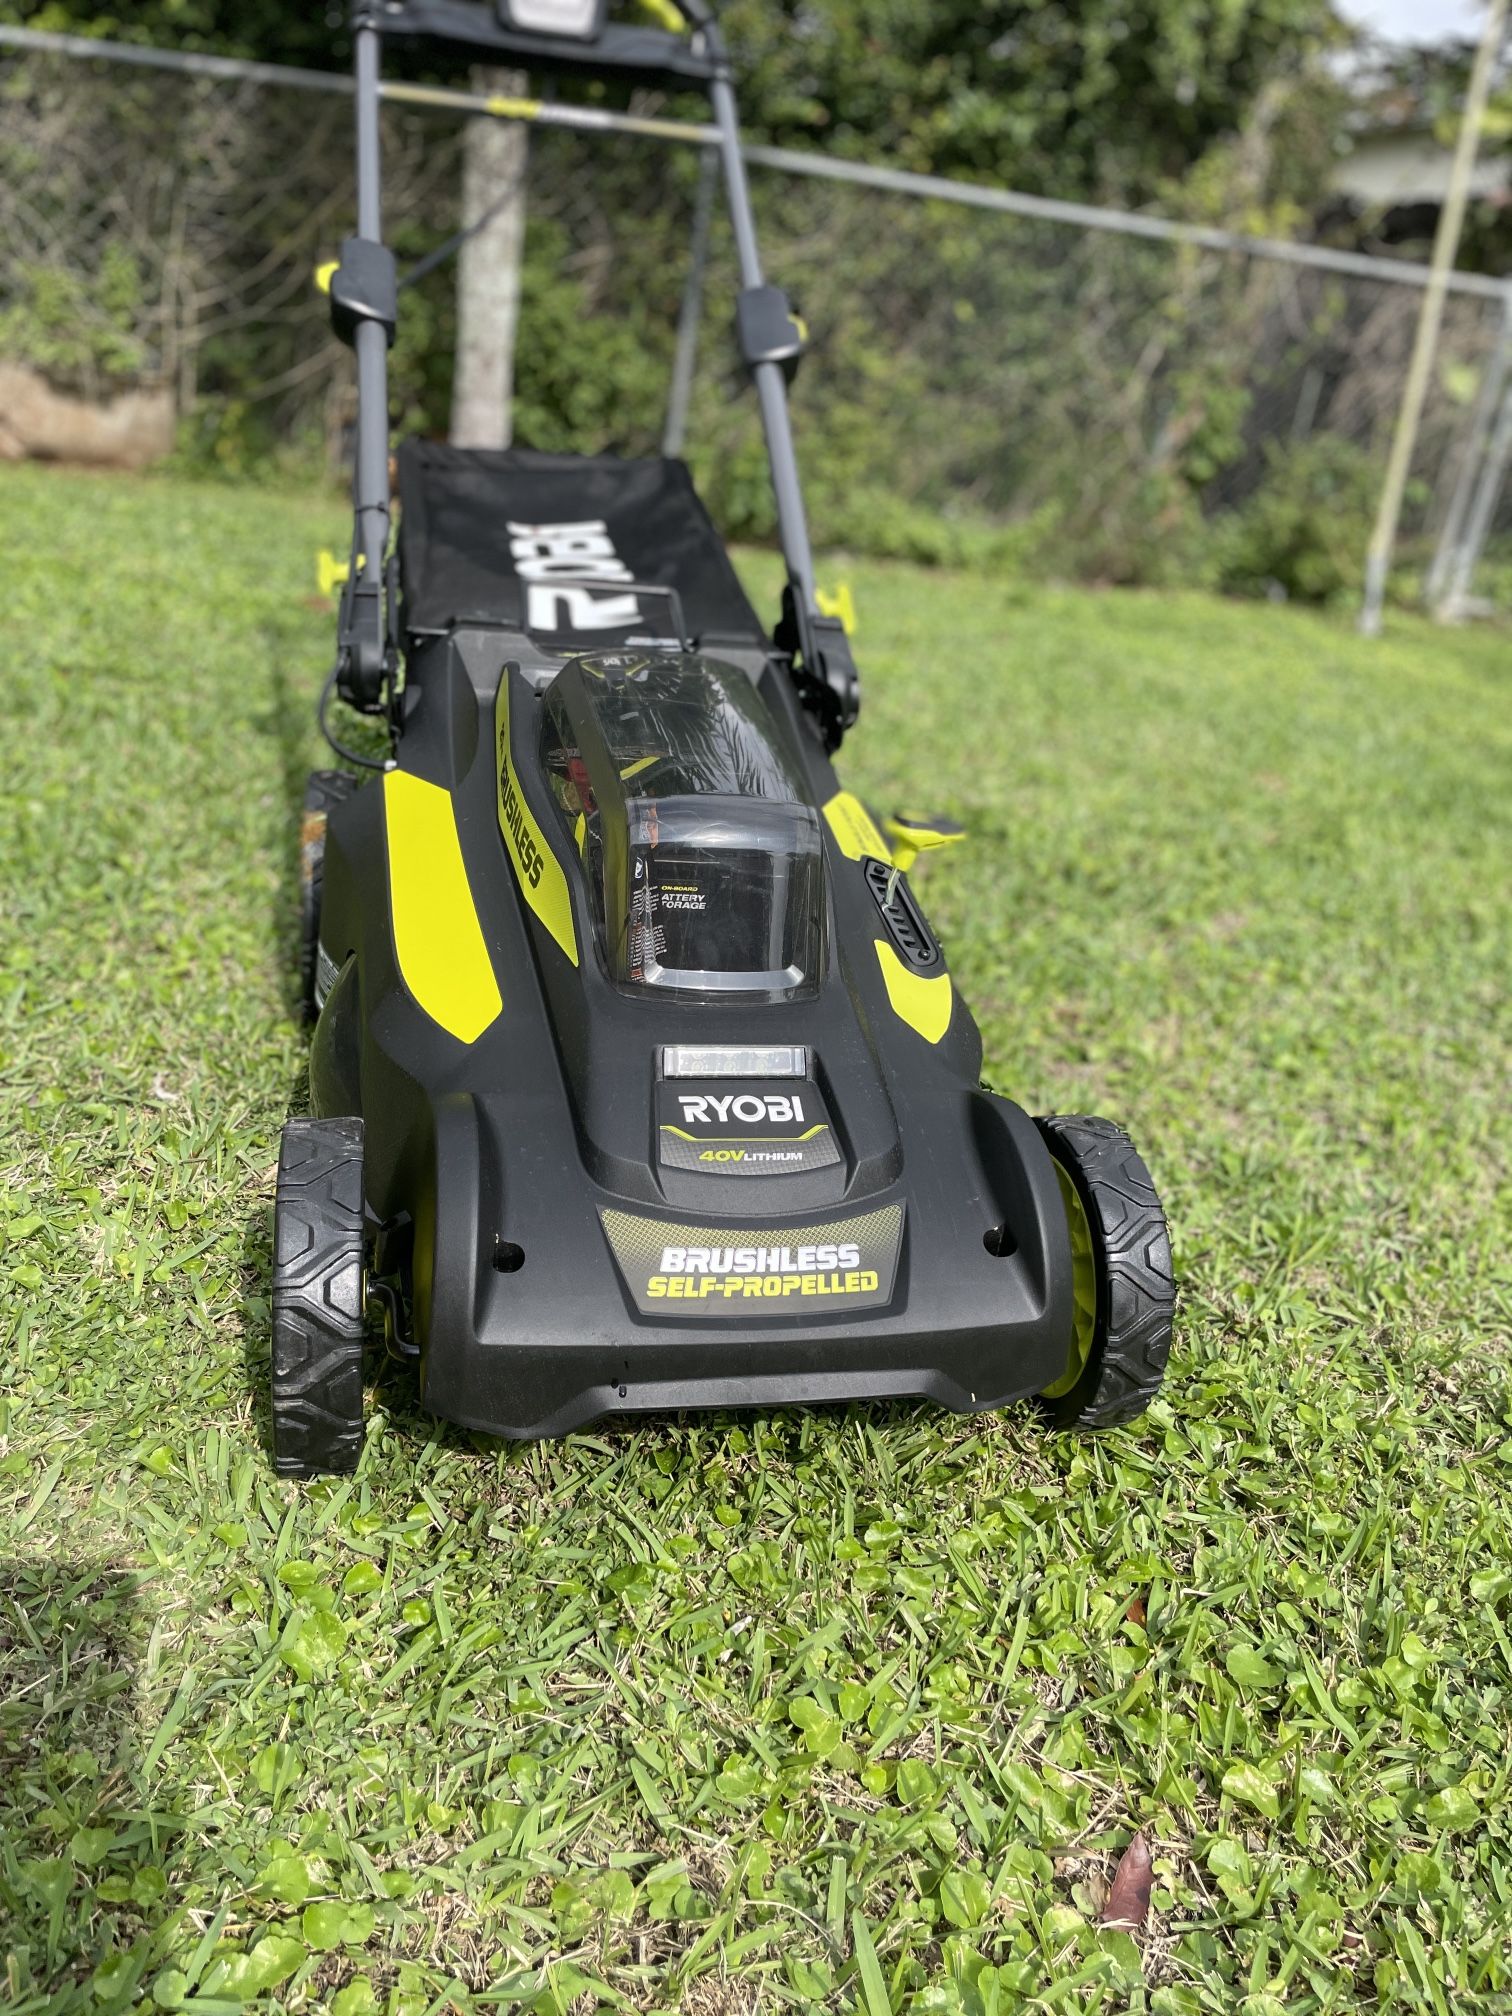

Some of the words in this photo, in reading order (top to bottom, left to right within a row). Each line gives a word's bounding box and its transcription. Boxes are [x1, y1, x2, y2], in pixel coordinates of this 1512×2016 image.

[506, 520, 643, 631] ROBI
[500, 755, 545, 889] USHLESS
[661, 893, 706, 901] ATTERY
[661, 901, 707, 909] TORAGE
[678, 1095, 805, 1122] RYOBI
[699, 1150, 745, 1161] 40V
[744, 1152, 803, 1161] LITHIUM
[659, 1243, 860, 1273] BRUSHLESS
[646, 1270, 879, 1298] SELF-PROPELLED
